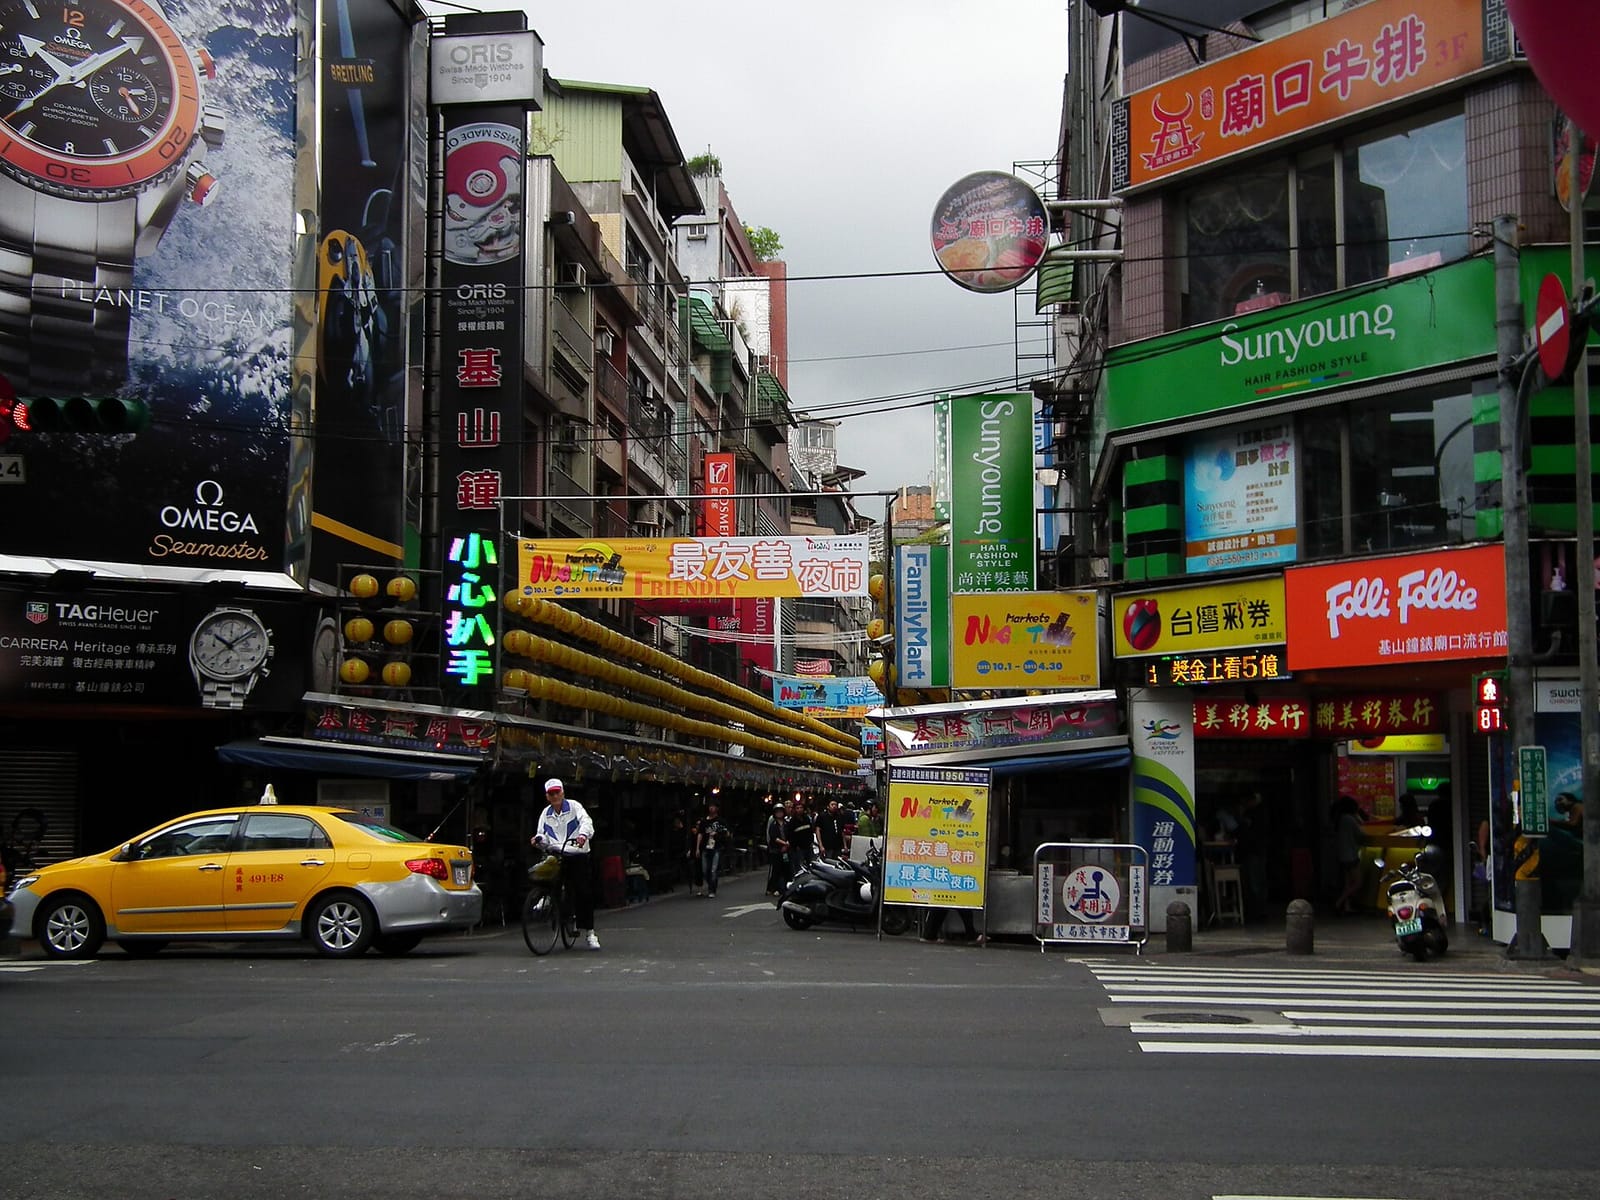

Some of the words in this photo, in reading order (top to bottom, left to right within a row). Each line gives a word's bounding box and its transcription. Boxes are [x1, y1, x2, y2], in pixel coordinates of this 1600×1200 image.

[63, 8, 85, 27] 12
[54, 35, 92, 51] OMEGA
[450, 43, 513, 65] ORIS
[1434, 32, 1469, 68] 3F
[29, 69, 44, 79] 15
[116, 73, 133, 82] 12
[331, 64, 374, 82] BREITLING
[440, 66, 462, 75] Swiss
[465, 64, 487, 73] Made
[489, 63, 525, 72] Watches
[451, 76, 473, 84] Since
[489, 74, 512, 82] 1904
[1220, 13, 1426, 138] 廟口牛排
[8, 82, 26, 92] 30
[42, 106, 100, 122] CHRONOMETER
[461, 128, 492, 141] MADE
[65, 141, 75, 154] 8
[46, 163, 91, 183] 30
[969, 215, 1044, 238] 廟口牛排
[457, 283, 506, 299] ORIS
[62, 279, 169, 313] PLANET
[179, 297, 275, 331] OCEAN
[1221, 304, 1396, 366] Sunyoung
[1244, 373, 1271, 387] HAIR
[1275, 362, 1326, 380] FASHION
[1331, 352, 1368, 369] STYLE
[456, 347, 502, 510] 基山鐘
[973, 400, 1014, 536] Sunyoung
[160, 505, 259, 535] OMEGA
[149, 534, 269, 561] Seamaster
[969, 552, 1018, 560] FASHION
[980, 544, 1007, 552] HAIR
[669, 541, 793, 582] 最友善
[976, 560, 1012, 568] STYLE
[798, 557, 862, 593] 夜市
[445, 533, 498, 685] 小心扒手
[1326, 577, 1391, 639] Folli
[1397, 567, 1478, 624] Follie
[906, 552, 927, 681] FamilyMart
[1006, 612, 1050, 624] Markets
[1171, 599, 1271, 637] 台灣彩券
[0, 636, 69, 651] CARRERA
[74, 640, 131, 656] Heritage
[1378, 630, 1508, 656] 基山鐘錶廟口流行館
[992, 661, 1012, 671] 10.1
[1038, 661, 1063, 671] 4.30
[1172, 654, 1279, 684] 獎金上看5億
[1549, 688, 1581, 698] swat
[911, 711, 971, 742] 基隆
[1028, 707, 1088, 731] 廟口
[1480, 708, 1501, 729] 87
[940, 771, 965, 781] 1950
[902, 840, 949, 857] 最友善
[951, 850, 975, 864] 夜市
[1152, 821, 1175, 885] 運動彩券
[900, 865, 949, 882] 最美味
[950, 876, 975, 889] 夜市
